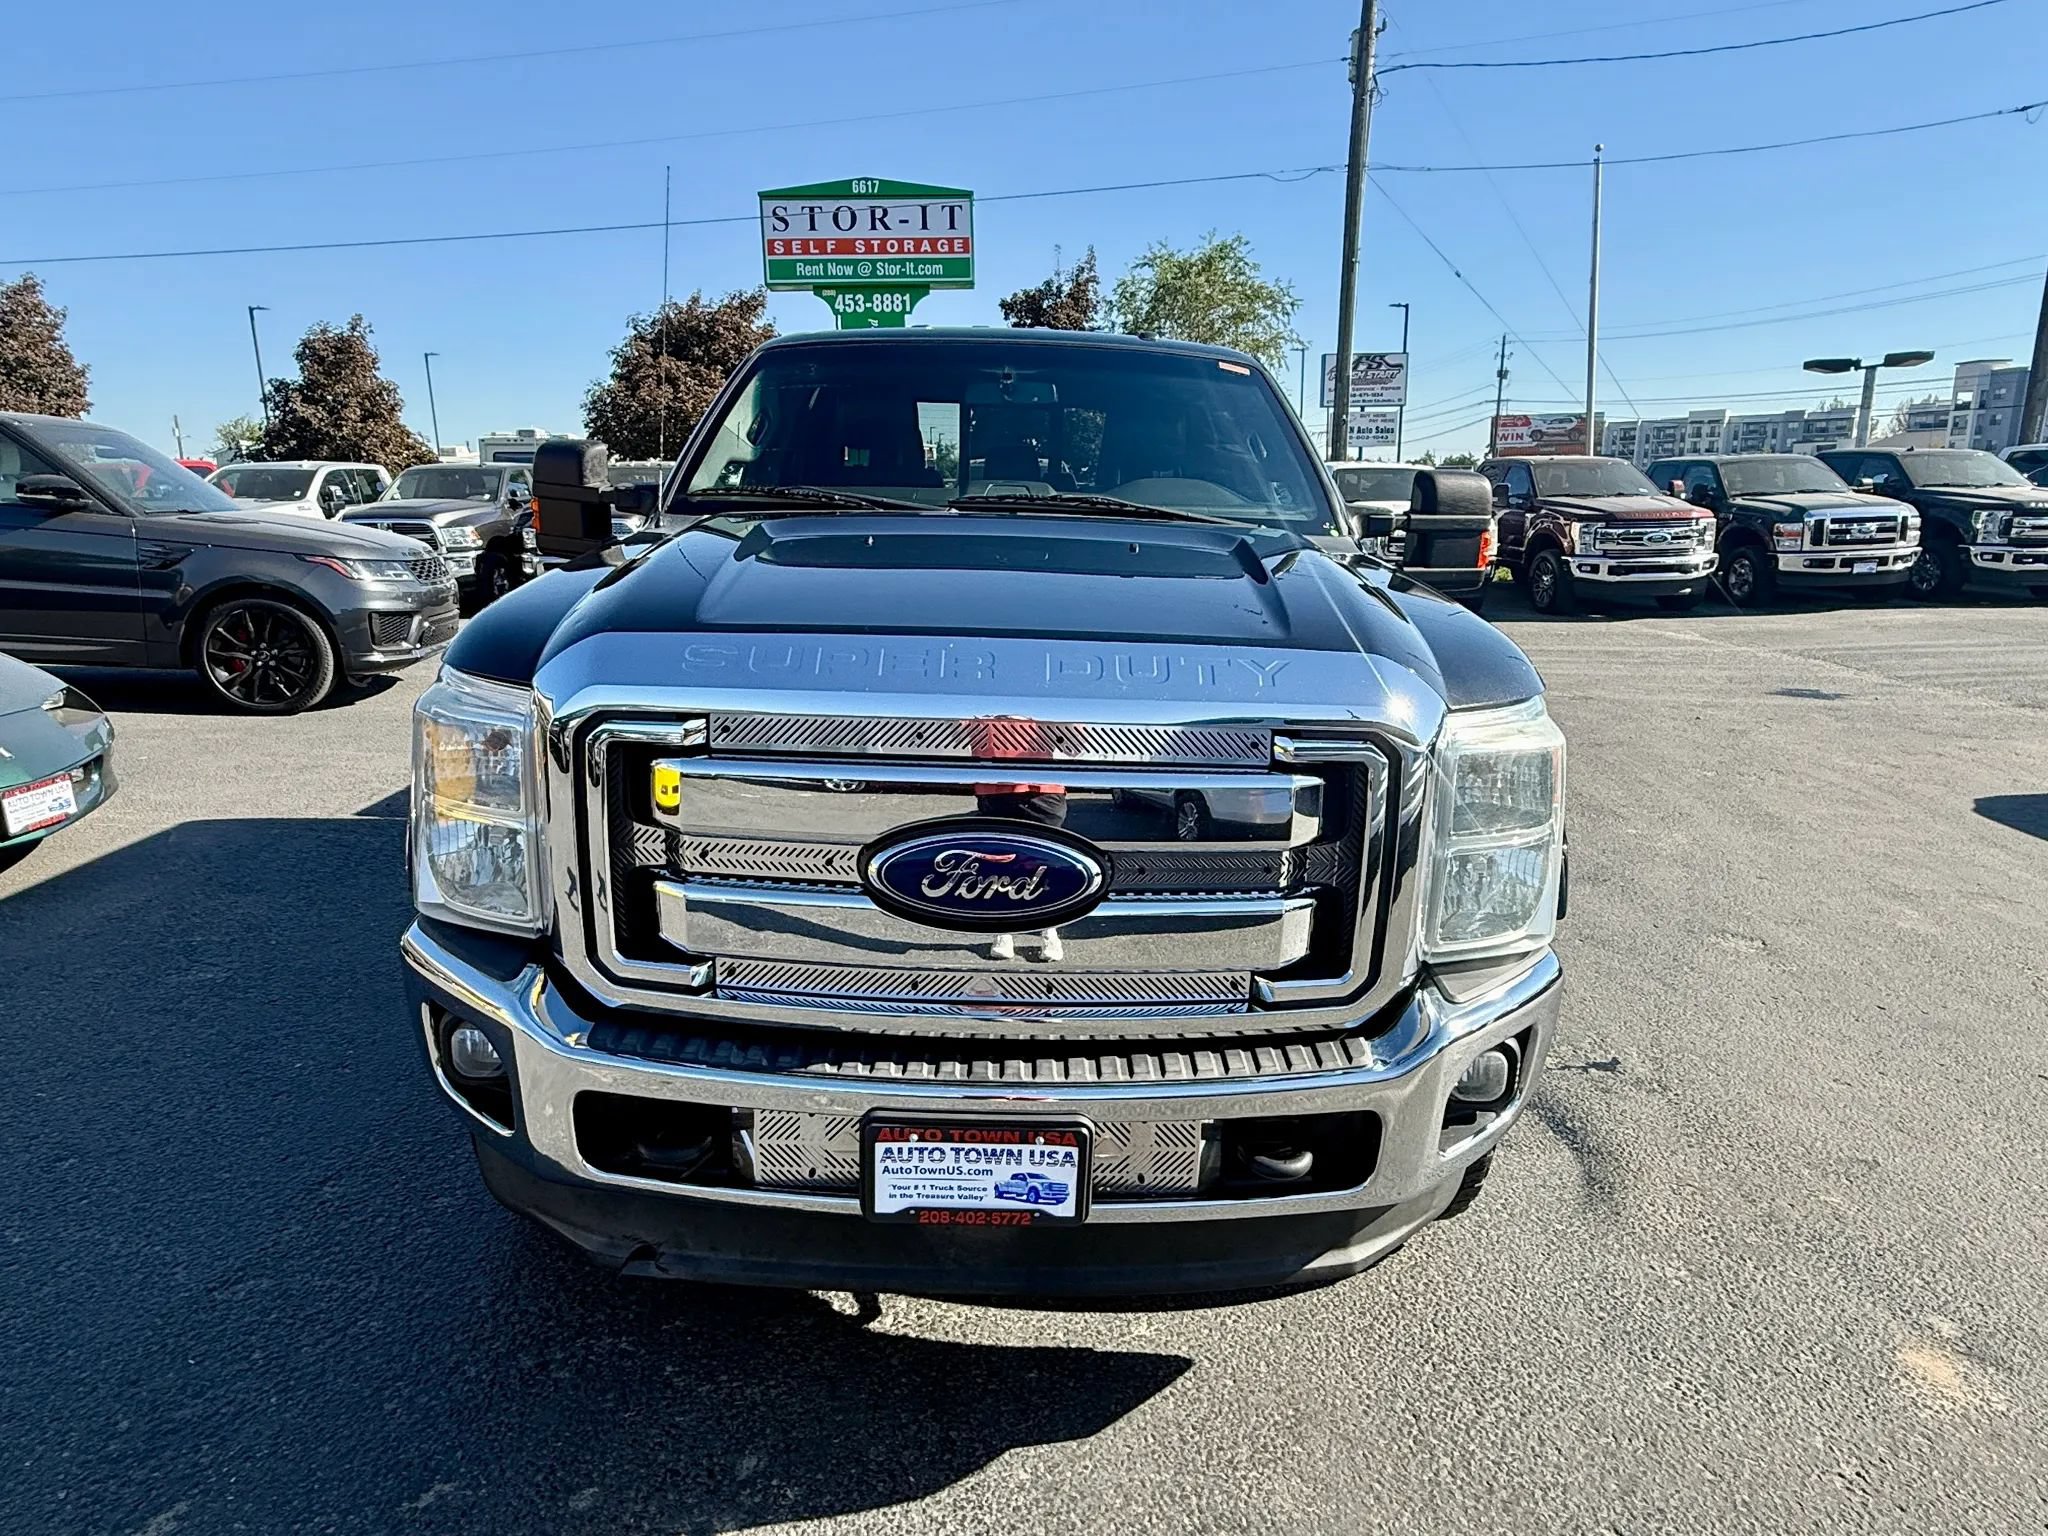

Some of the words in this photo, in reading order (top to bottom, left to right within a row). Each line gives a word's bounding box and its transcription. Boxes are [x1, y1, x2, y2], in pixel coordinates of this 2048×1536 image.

[852, 180, 879, 194] 6617
[772, 205, 963, 232] STOR-IT
[774, 240, 836, 254] SELF
[855, 239, 965, 254] STORAGE
[796, 262, 824, 276] Rent
[827, 262, 853, 276] Now
[857, 262, 872, 277] @
[876, 261, 943, 276] Stor-It.com
[834, 293, 911, 313] 453-8881
[1357, 426, 1373, 434] Auto
[1375, 426, 1395, 434] Sales
[1500, 432, 1524, 442] WIN
[682, 645, 994, 680] SUPER
[1046, 652, 1292, 687] DUTY
[921, 850, 1047, 900] Ford
[878, 1128, 943, 1142] AUTO
[949, 1129, 1020, 1144] TOWN
[1028, 1131, 1078, 1146] USA
[880, 1147, 946, 1164] AUTO
[950, 1147, 1022, 1166] TOWN
[1029, 1150, 1077, 1168] USA
[882, 1166, 993, 1176] AutoTownUS.com
